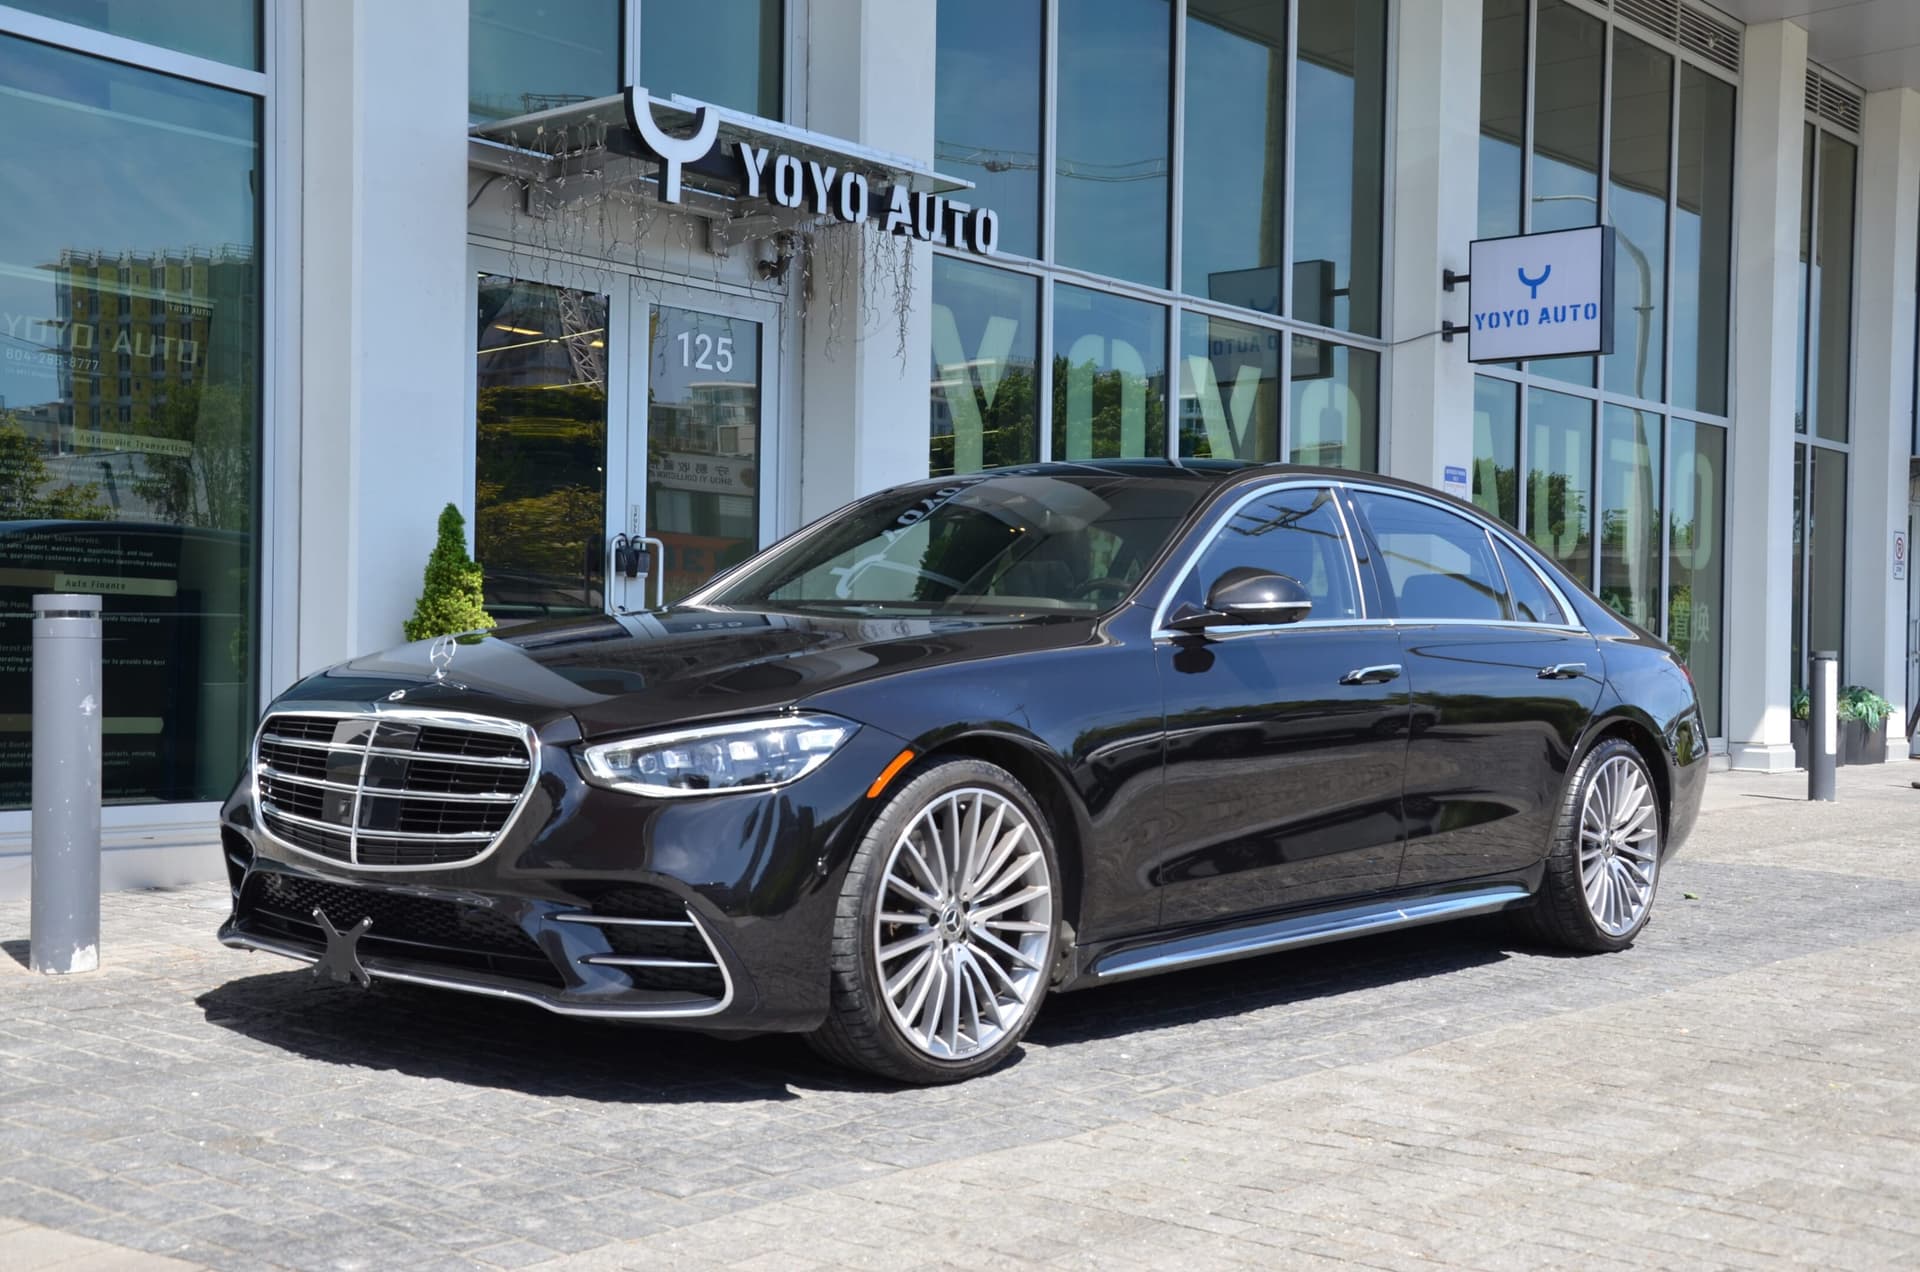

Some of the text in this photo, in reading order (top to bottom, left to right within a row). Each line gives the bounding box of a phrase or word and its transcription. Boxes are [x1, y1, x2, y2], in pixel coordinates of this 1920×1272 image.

[737, 142, 999, 255] YOYO AUTO
[3, 311, 200, 364] YOYO AUTO
[1474, 303, 1597, 330] YOYO AUTO
[677, 331, 733, 373] 125
[65, 579, 126, 591] Auto Finance
